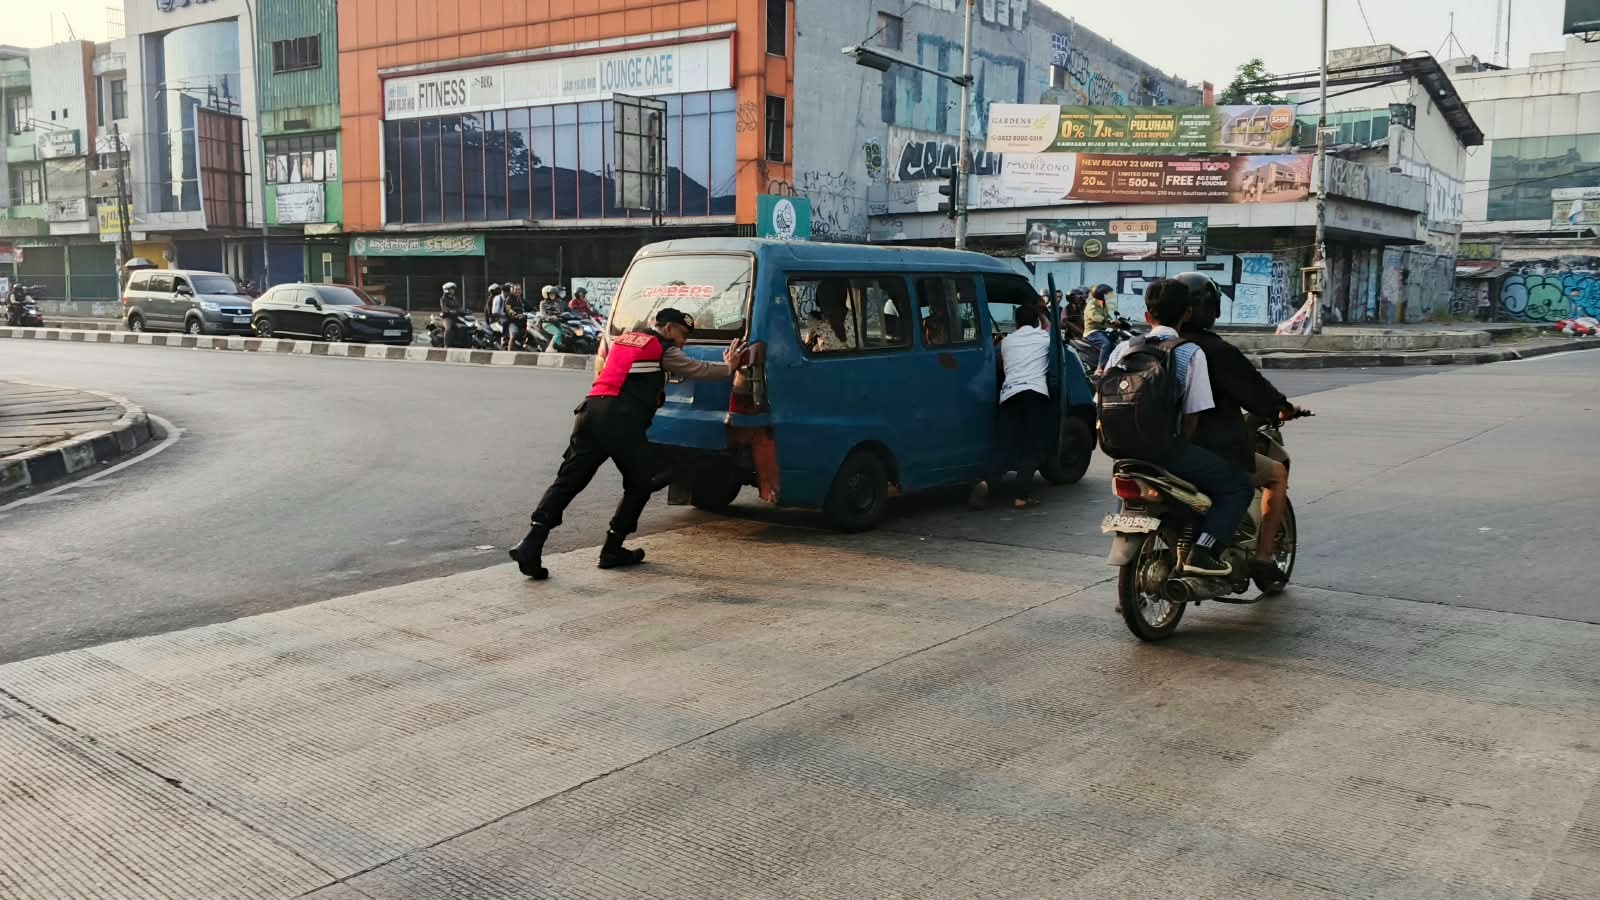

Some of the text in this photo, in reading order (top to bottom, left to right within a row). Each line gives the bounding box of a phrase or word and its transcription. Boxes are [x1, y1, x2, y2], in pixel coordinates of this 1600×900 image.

[600, 54, 673, 90] LOUNGE CAFE
[480, 76, 493, 88] BUKA
[418, 79, 466, 109] FITNESS
[1062, 120, 1085, 138] 0%
[1130, 120, 1174, 131] PULUHAN
[1007, 161, 1070, 172] MORIZONO
[1081, 159, 1100, 167] NEW
[1102, 159, 1128, 167] READY
[1129, 160, 1139, 168] 22
[1140, 160, 1164, 168] UNITS
[1082, 176, 1097, 186] 20
[1128, 178, 1149, 187] 500
[1165, 175, 1195, 186] FREE
[369, 239, 420, 251] Angkringan
